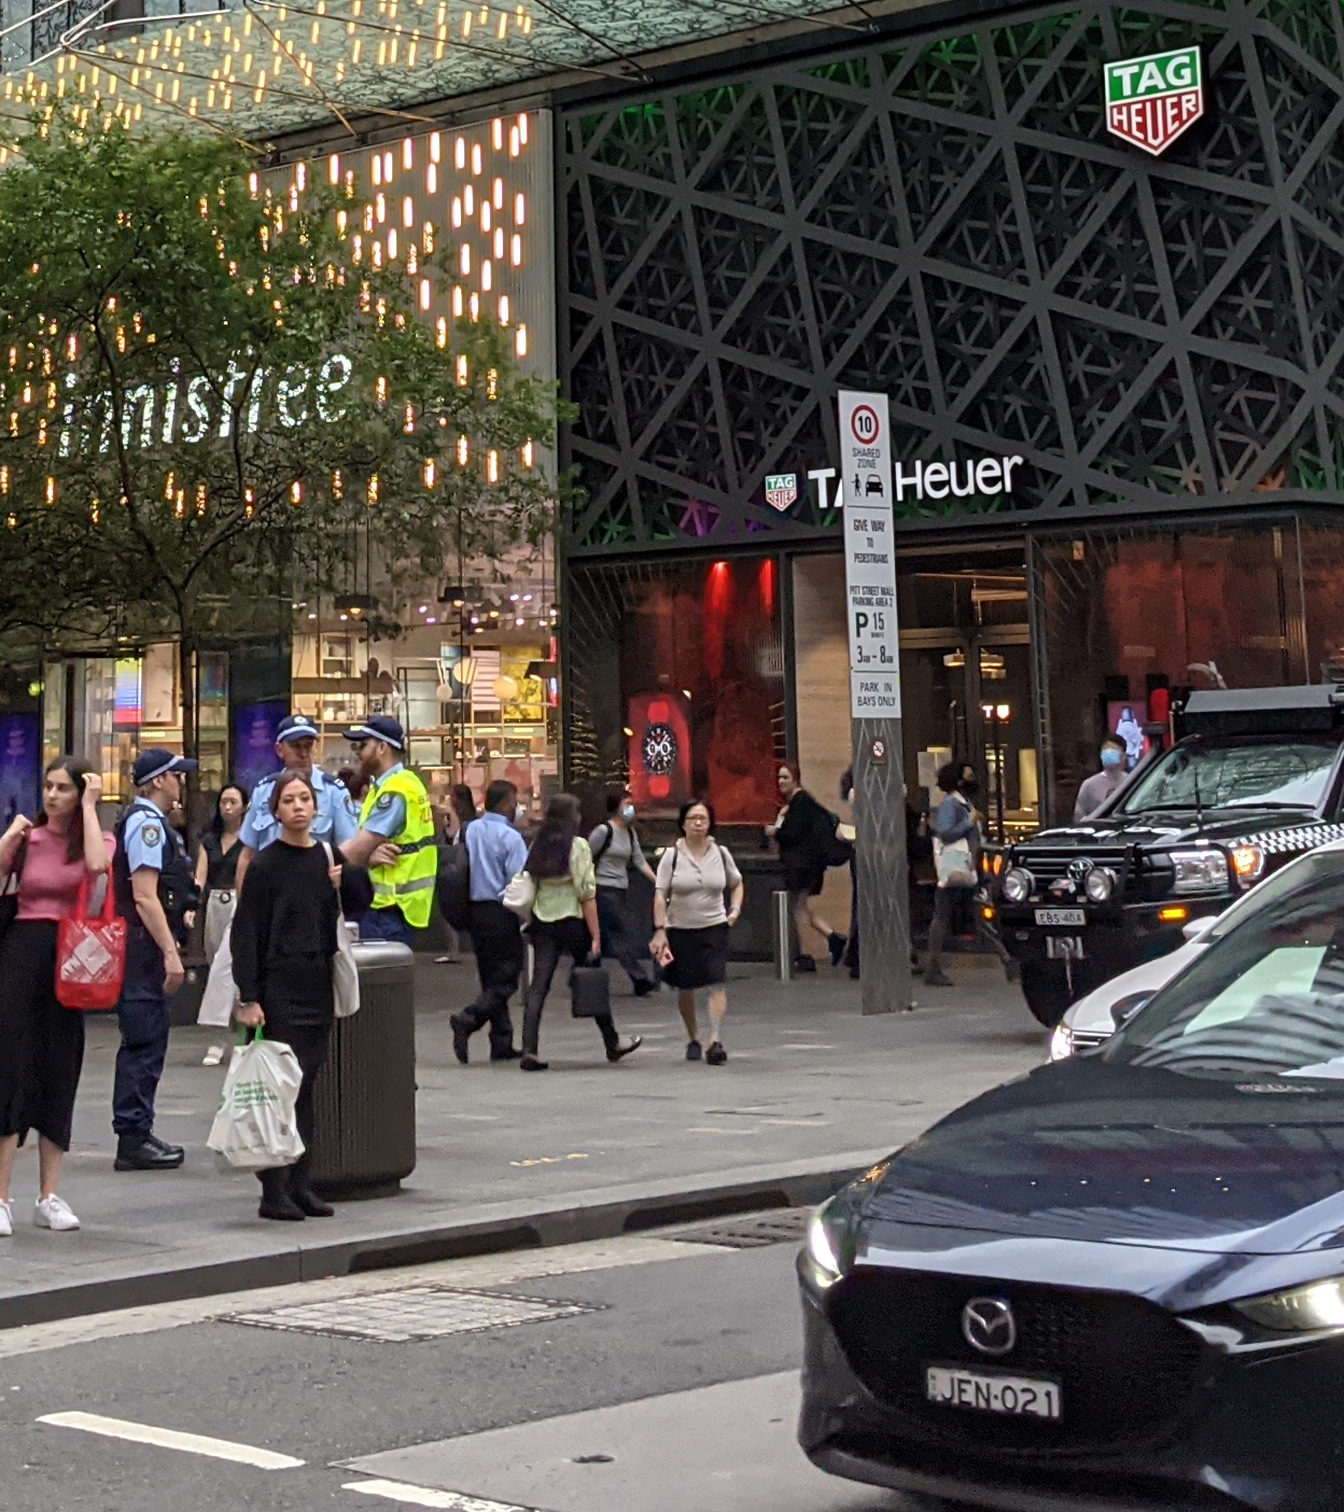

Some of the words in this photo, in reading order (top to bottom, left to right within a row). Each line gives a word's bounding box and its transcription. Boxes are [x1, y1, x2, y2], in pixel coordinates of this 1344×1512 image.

[1112, 55, 1192, 97] TAG
[1112, 93, 1197, 147] HEUER
[858, 415, 873, 434] 10
[852, 447, 881, 459] SHARED
[857, 458, 877, 469] ZONE
[768, 475, 795, 489] TAG
[853, 519, 868, 532] GIVE
[870, 520, 886, 533] WAY
[855, 612, 869, 638] P
[872, 612, 885, 631] 15
[860, 682, 879, 693] PARK
[883, 682, 893, 693] IN
[857, 696, 876, 707] BAYS
[877, 696, 896, 707] ONLY
